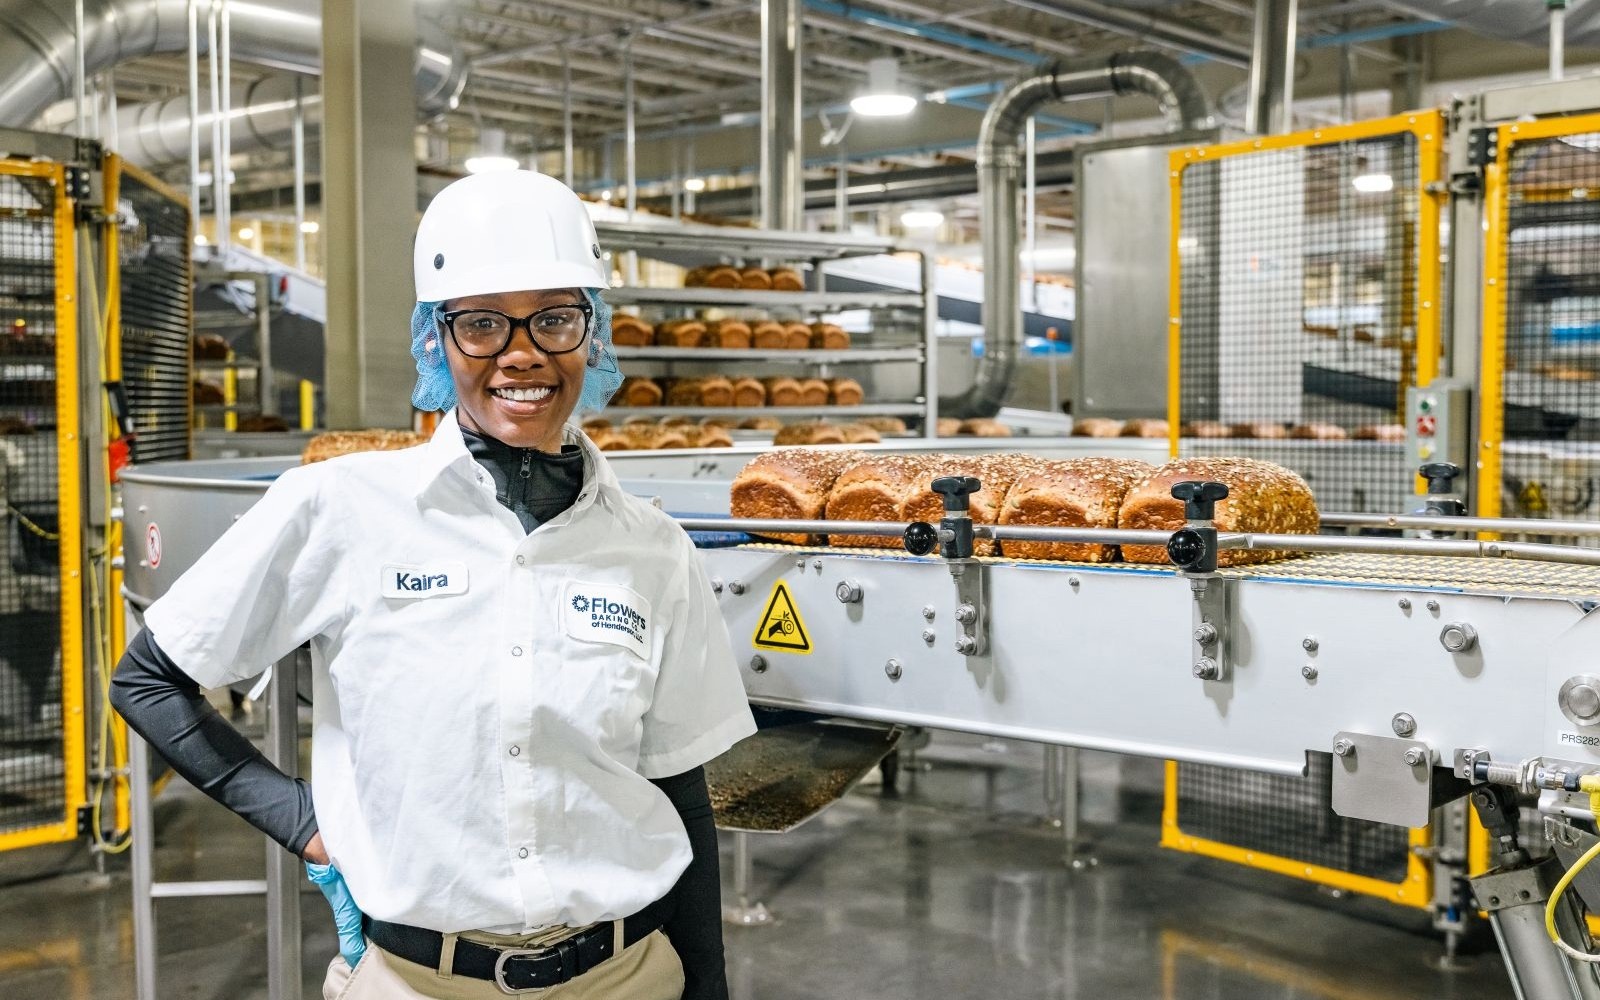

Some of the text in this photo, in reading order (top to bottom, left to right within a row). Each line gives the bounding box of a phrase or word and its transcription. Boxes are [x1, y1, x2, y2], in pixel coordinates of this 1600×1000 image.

[396, 572, 449, 591] Kaira
[591, 597, 646, 630] Flowers
[592, 613, 629, 625] BAKING
